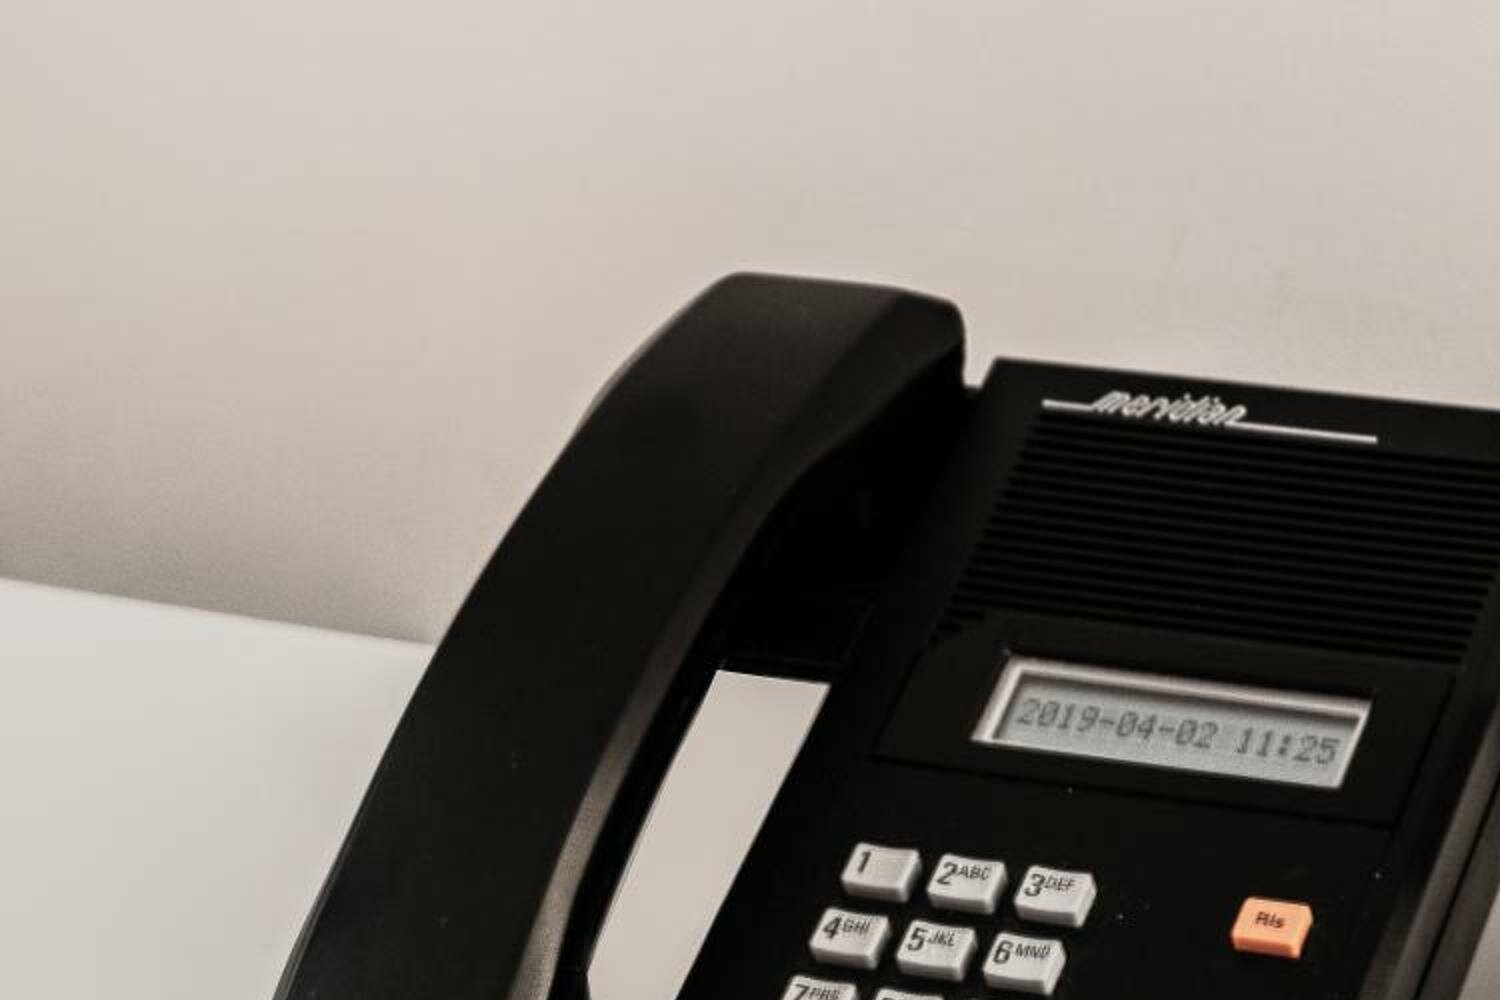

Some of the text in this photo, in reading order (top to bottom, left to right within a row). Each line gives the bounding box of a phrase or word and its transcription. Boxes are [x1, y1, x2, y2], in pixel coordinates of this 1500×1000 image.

[1015, 696, 1343, 766] 2019-04-02 11:25
[857, 851, 871, 872] 1
